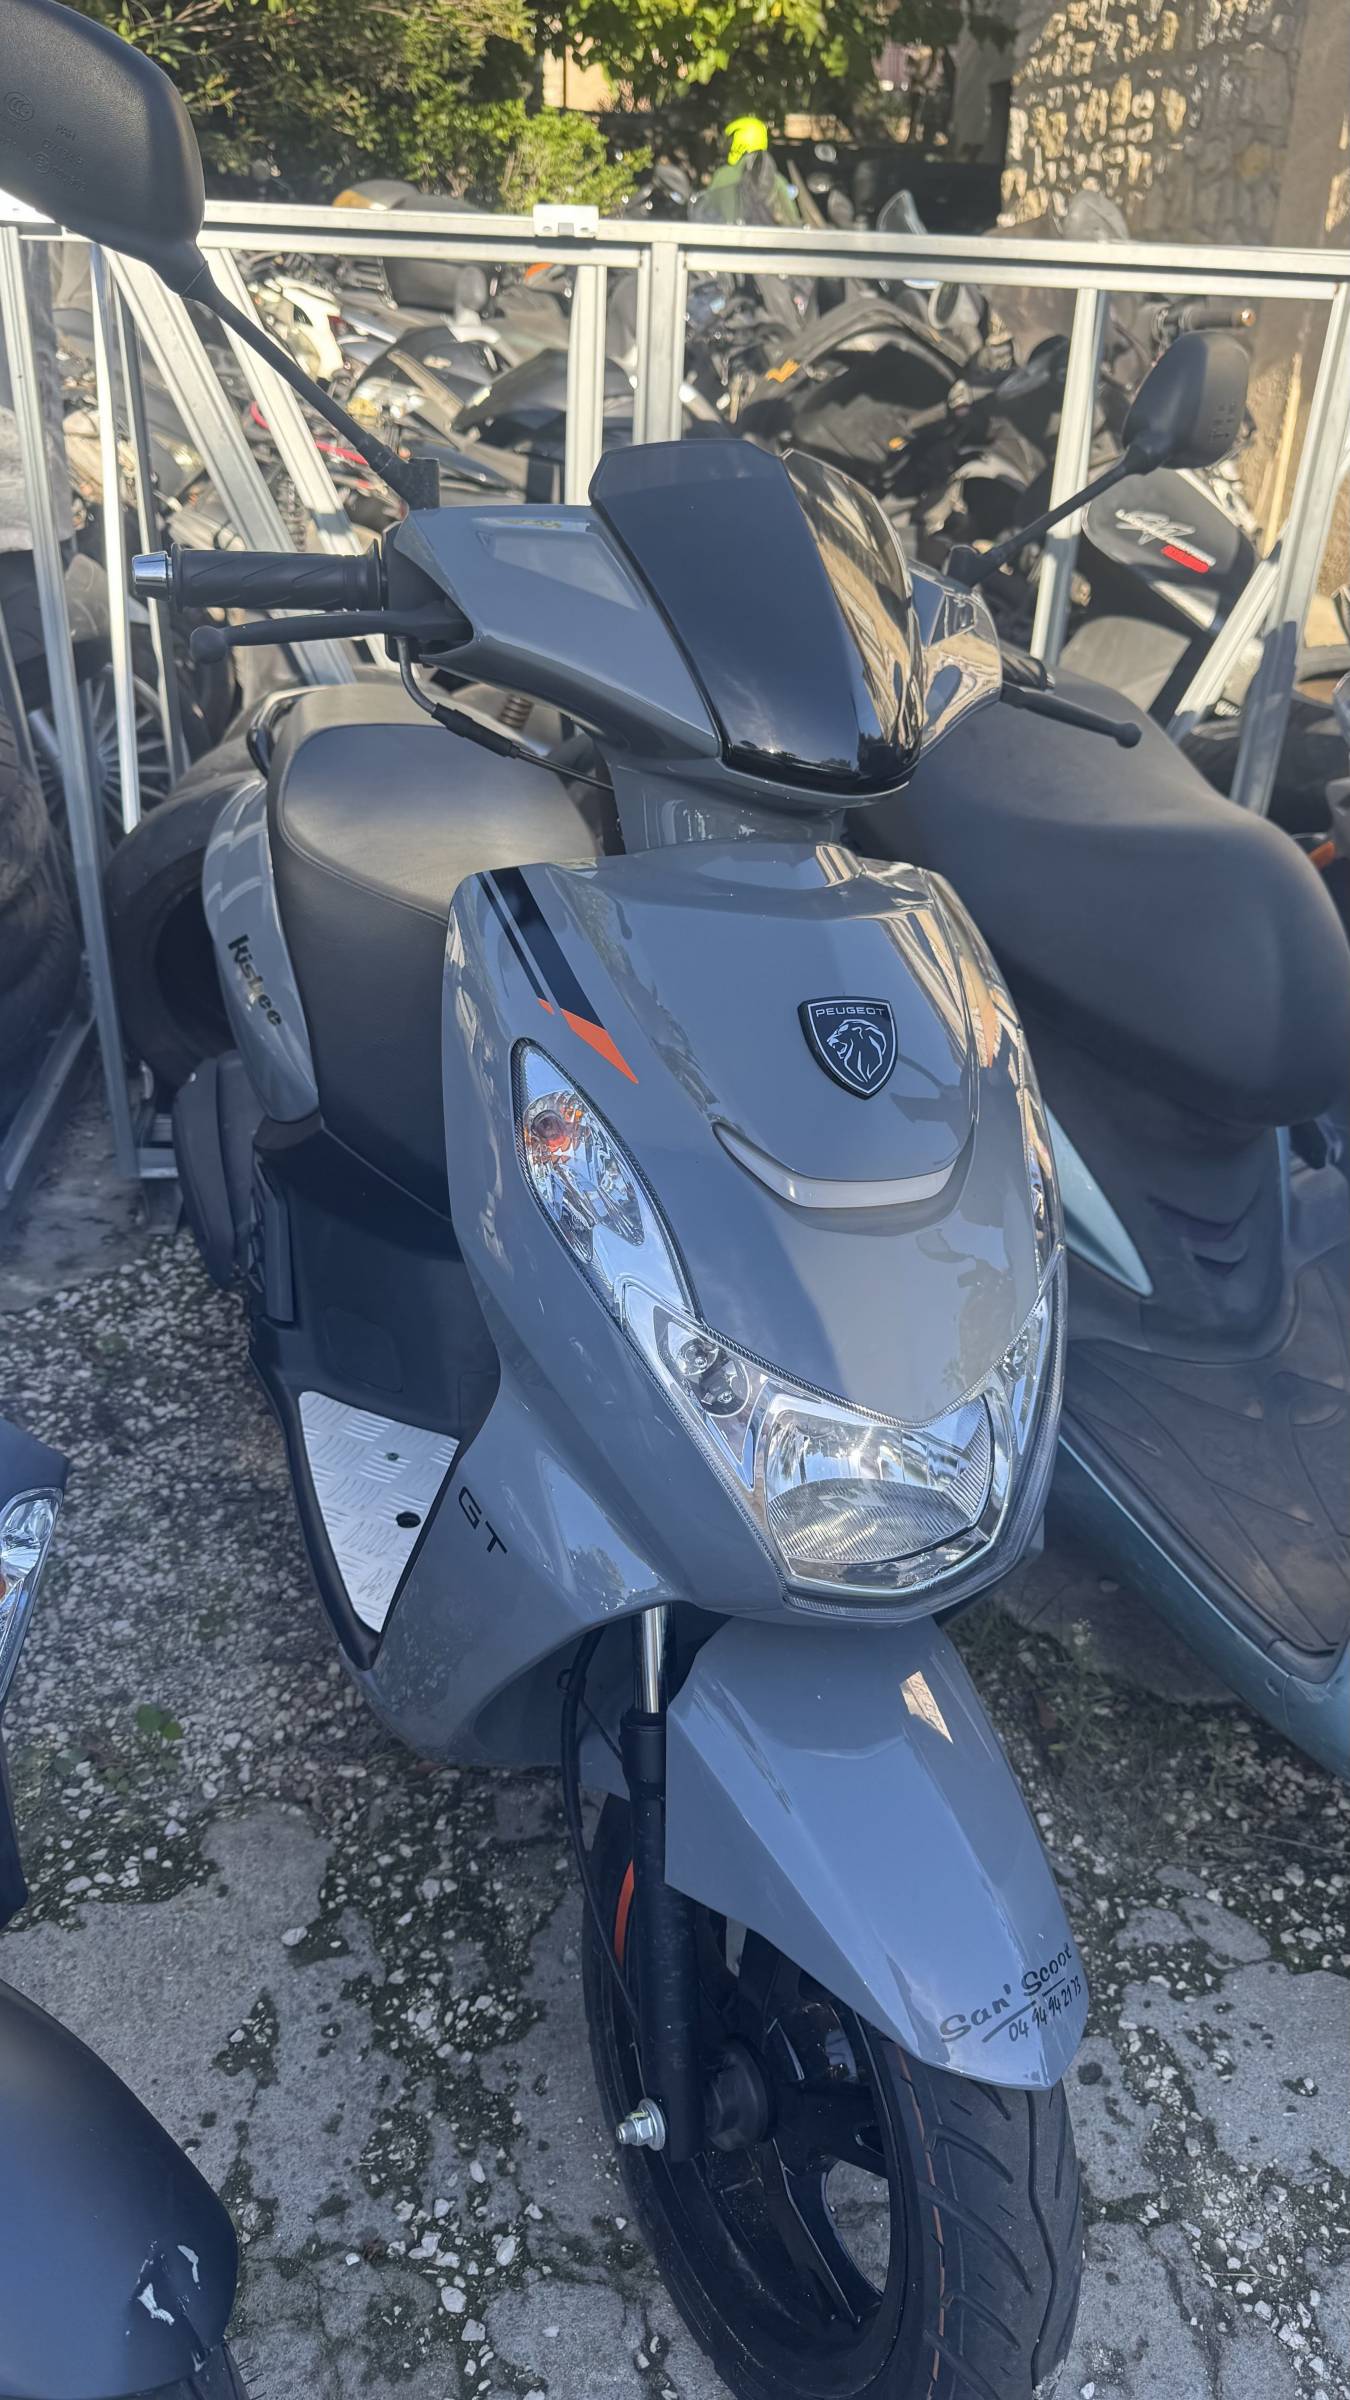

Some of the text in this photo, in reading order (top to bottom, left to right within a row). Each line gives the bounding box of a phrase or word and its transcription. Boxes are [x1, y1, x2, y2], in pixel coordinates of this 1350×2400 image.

[816, 1006, 884, 1018] PEUGEOT
[459, 1486, 508, 1554] GT
[1022, 1943, 1072, 1997] Scoot
[1009, 2018, 1029, 2042] 04
[1048, 1995, 1062, 2017] 94
